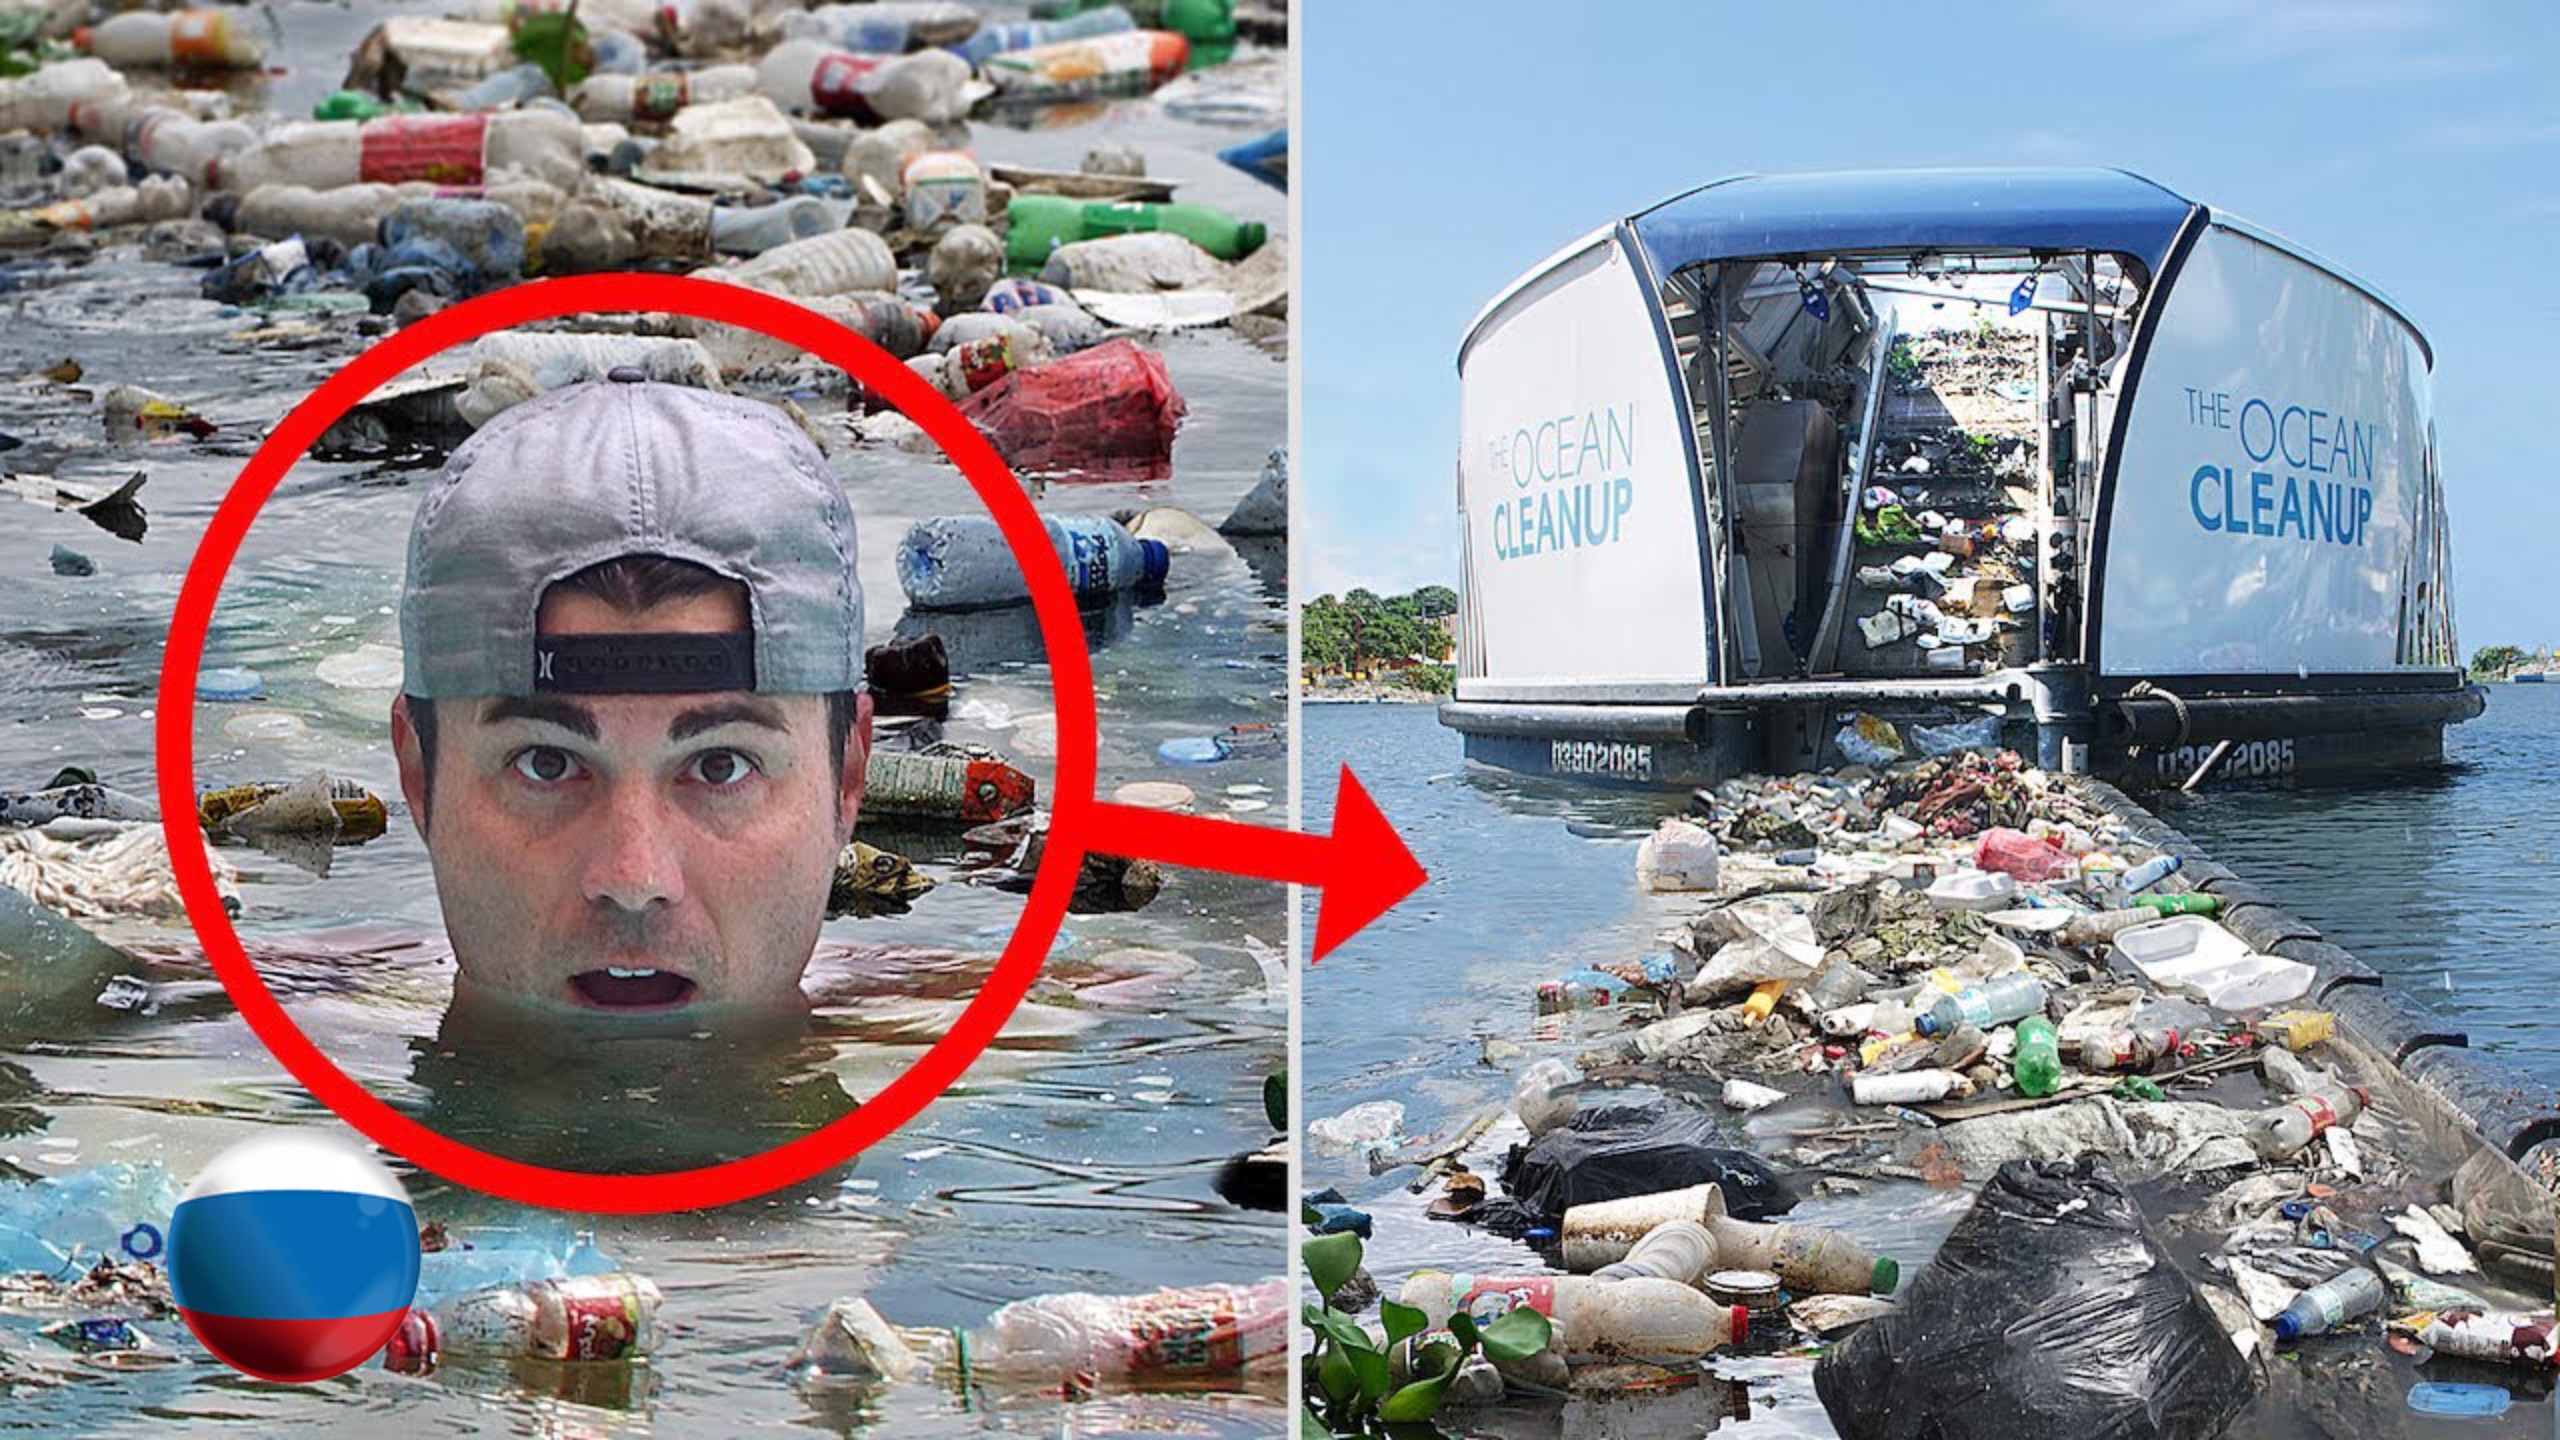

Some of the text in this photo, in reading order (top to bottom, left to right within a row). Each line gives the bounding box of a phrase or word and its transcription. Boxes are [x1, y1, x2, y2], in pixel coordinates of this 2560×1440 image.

[1512, 403, 1633, 488] OCEAN
[2185, 387, 2372, 481] THE OCEAN
[1493, 478, 1633, 561] CLEANUP
[2190, 464, 2372, 546] CLEANUP
